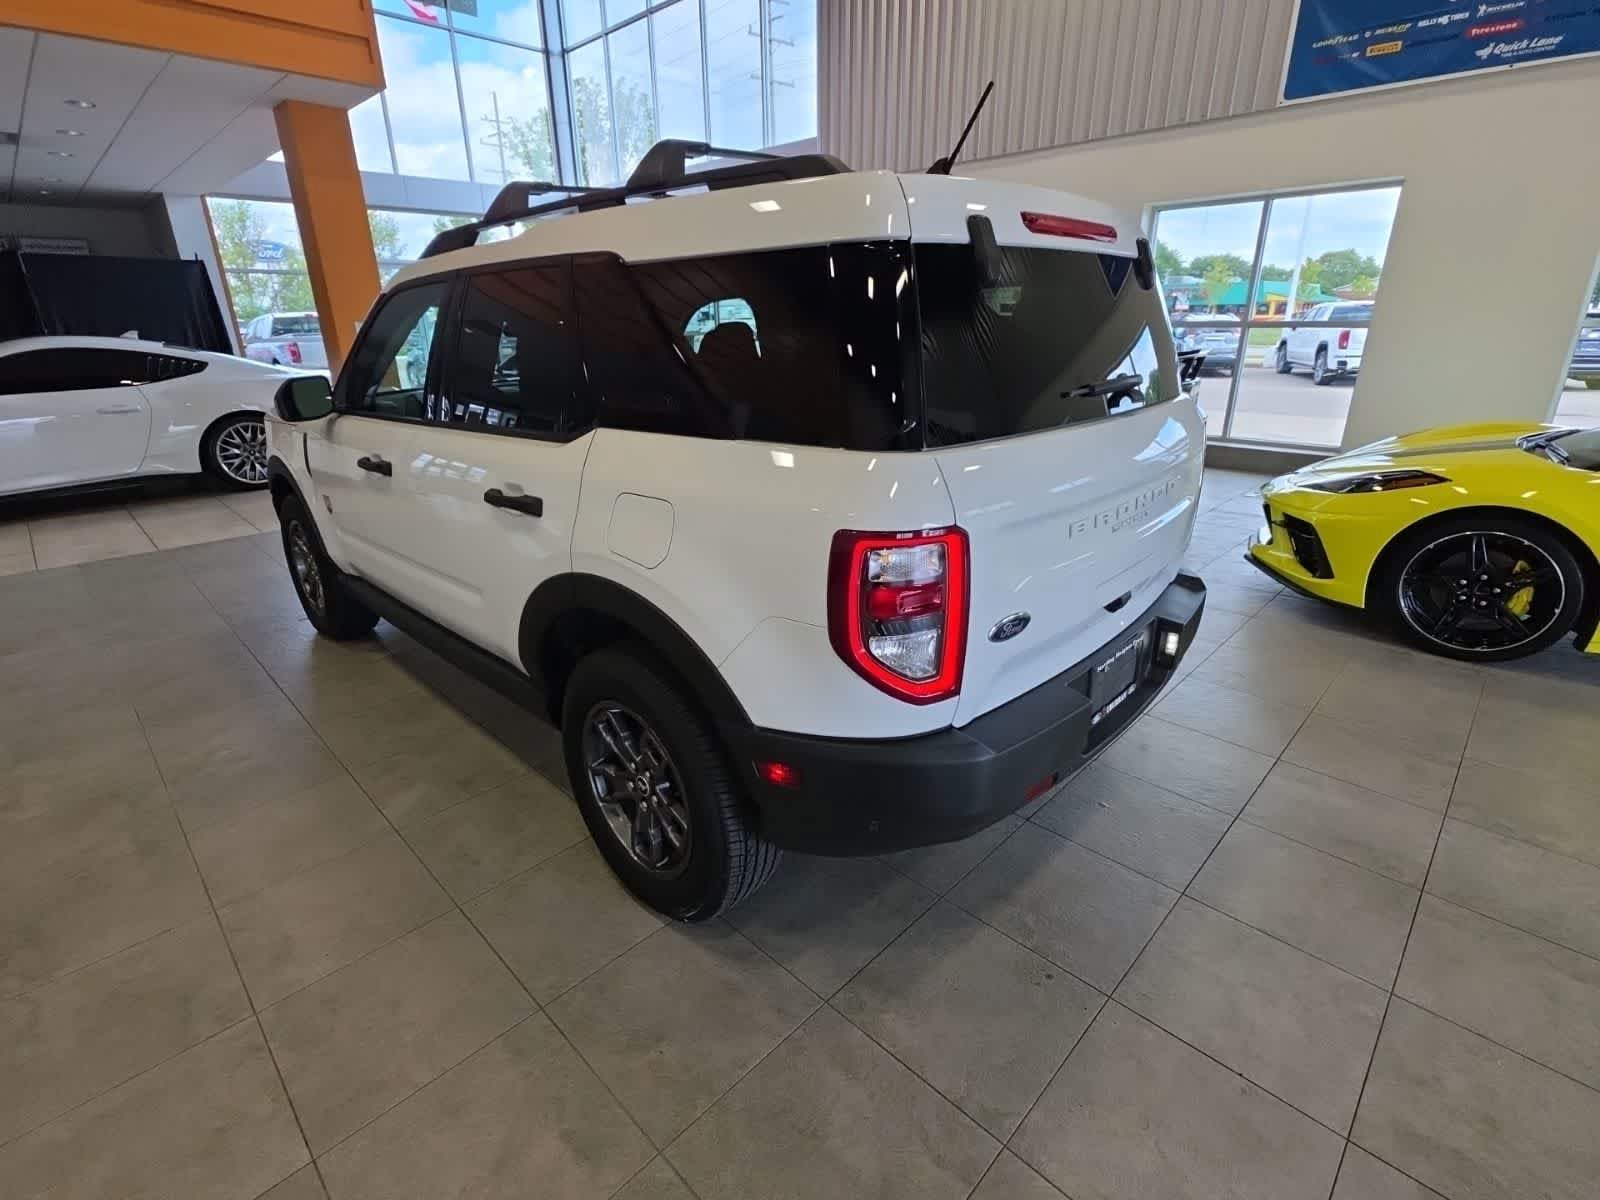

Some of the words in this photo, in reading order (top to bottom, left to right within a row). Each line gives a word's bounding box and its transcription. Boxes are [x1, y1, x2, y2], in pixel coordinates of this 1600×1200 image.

[1418, 17, 1437, 27] KELLY
[1471, 21, 1518, 36] Firestone
[1312, 34, 1359, 48] GOODYEAR
[1494, 39, 1529, 54] Quick
[1529, 35, 1564, 47] Lane
[1068, 477, 1178, 541] BRONCO
[1000, 620, 1024, 637] Ford
